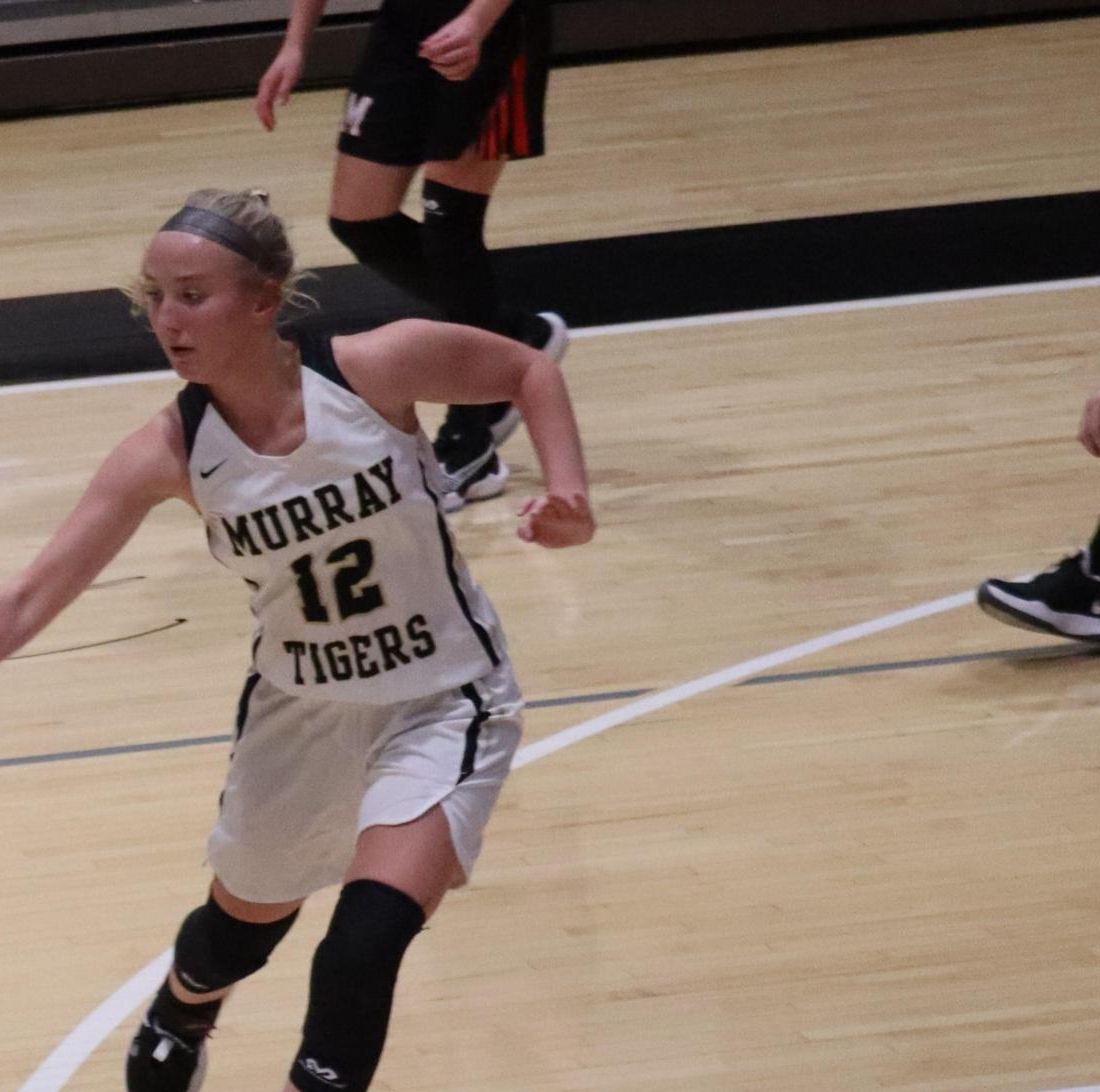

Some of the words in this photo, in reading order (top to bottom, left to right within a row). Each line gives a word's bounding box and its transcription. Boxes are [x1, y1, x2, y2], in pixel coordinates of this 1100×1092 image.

[221, 456, 402, 557] MURRAY
[290, 537, 384, 624] 12
[283, 613, 437, 685] TIGERS
